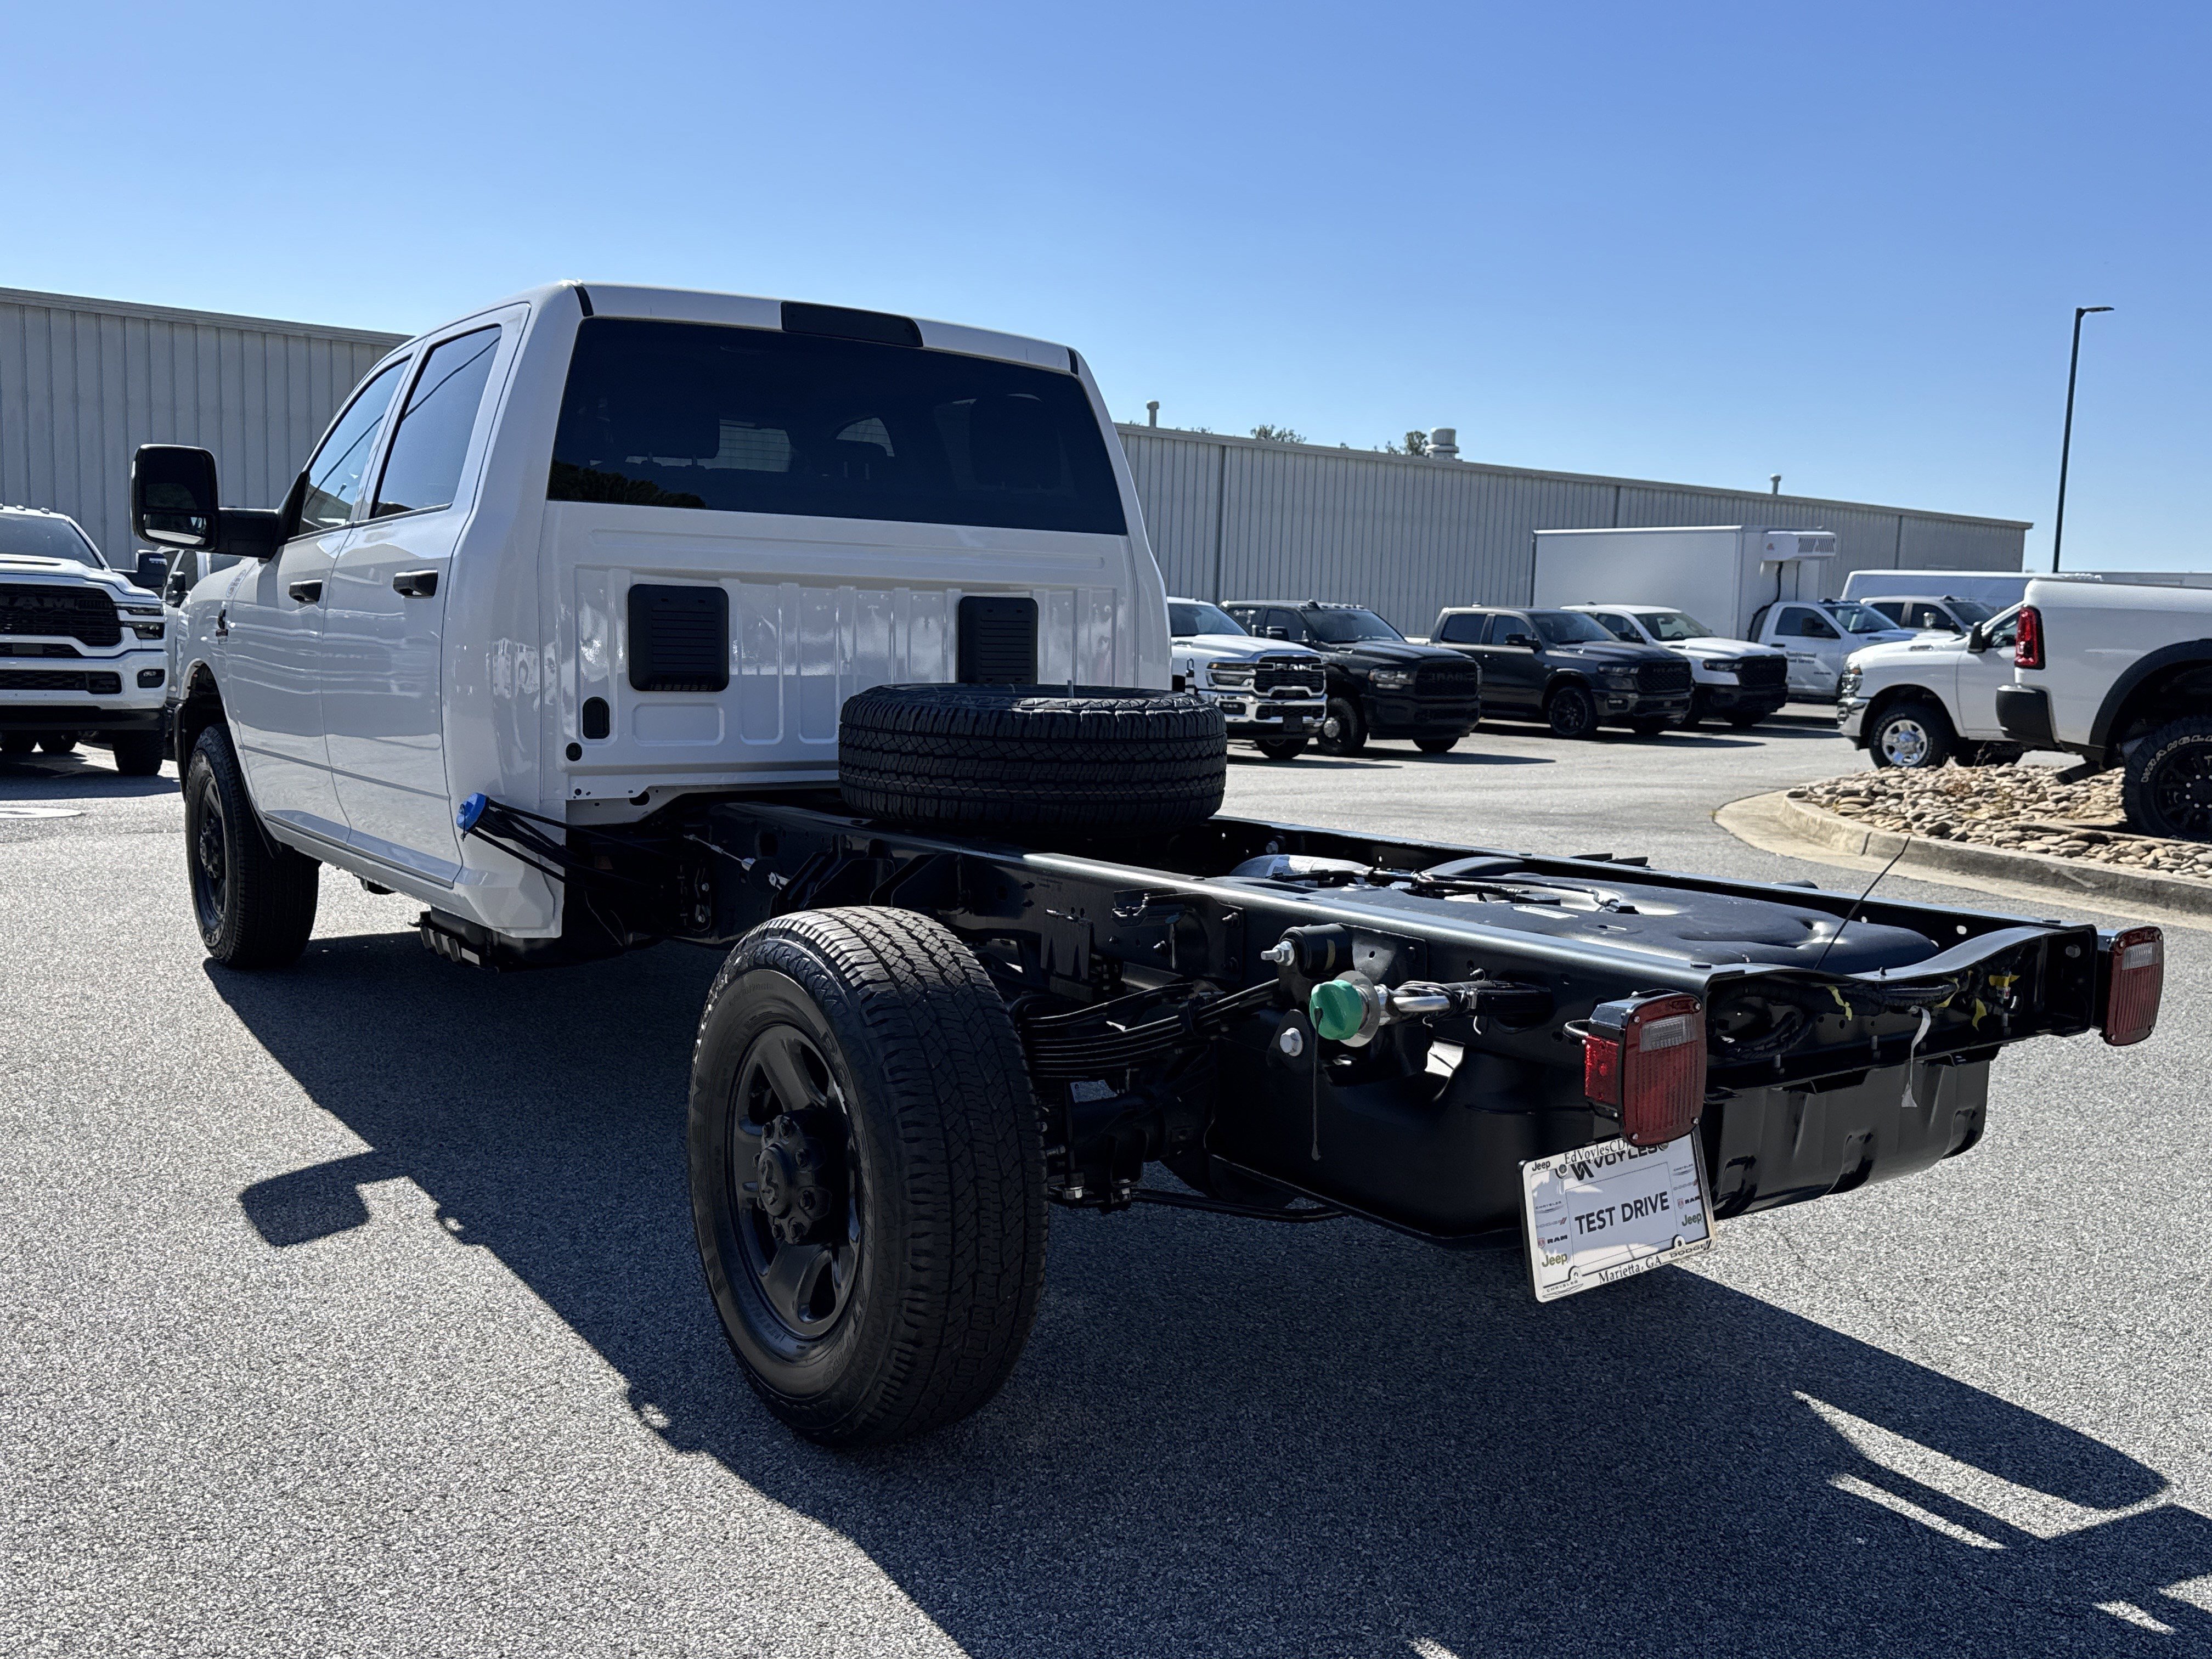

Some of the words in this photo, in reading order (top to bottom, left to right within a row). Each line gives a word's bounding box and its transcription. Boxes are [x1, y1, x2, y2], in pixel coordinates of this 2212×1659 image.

[1276, 663, 1312, 671] RAM
[1532, 1160, 1551, 1172] Jeep
[1685, 1195, 1700, 1204] RAM
[1575, 1206, 1616, 1234] TEST
[1621, 1191, 1669, 1222] DRIVE
[1681, 1213, 1702, 1226] Jeep
[1547, 1234, 1568, 1244] RAM
[1542, 1254, 1568, 1267] Jeep
[1598, 1263, 1644, 1284] Marietta,
[1645, 1255, 1662, 1268] GA
[1547, 1280, 1578, 1293] CHRYSLER
